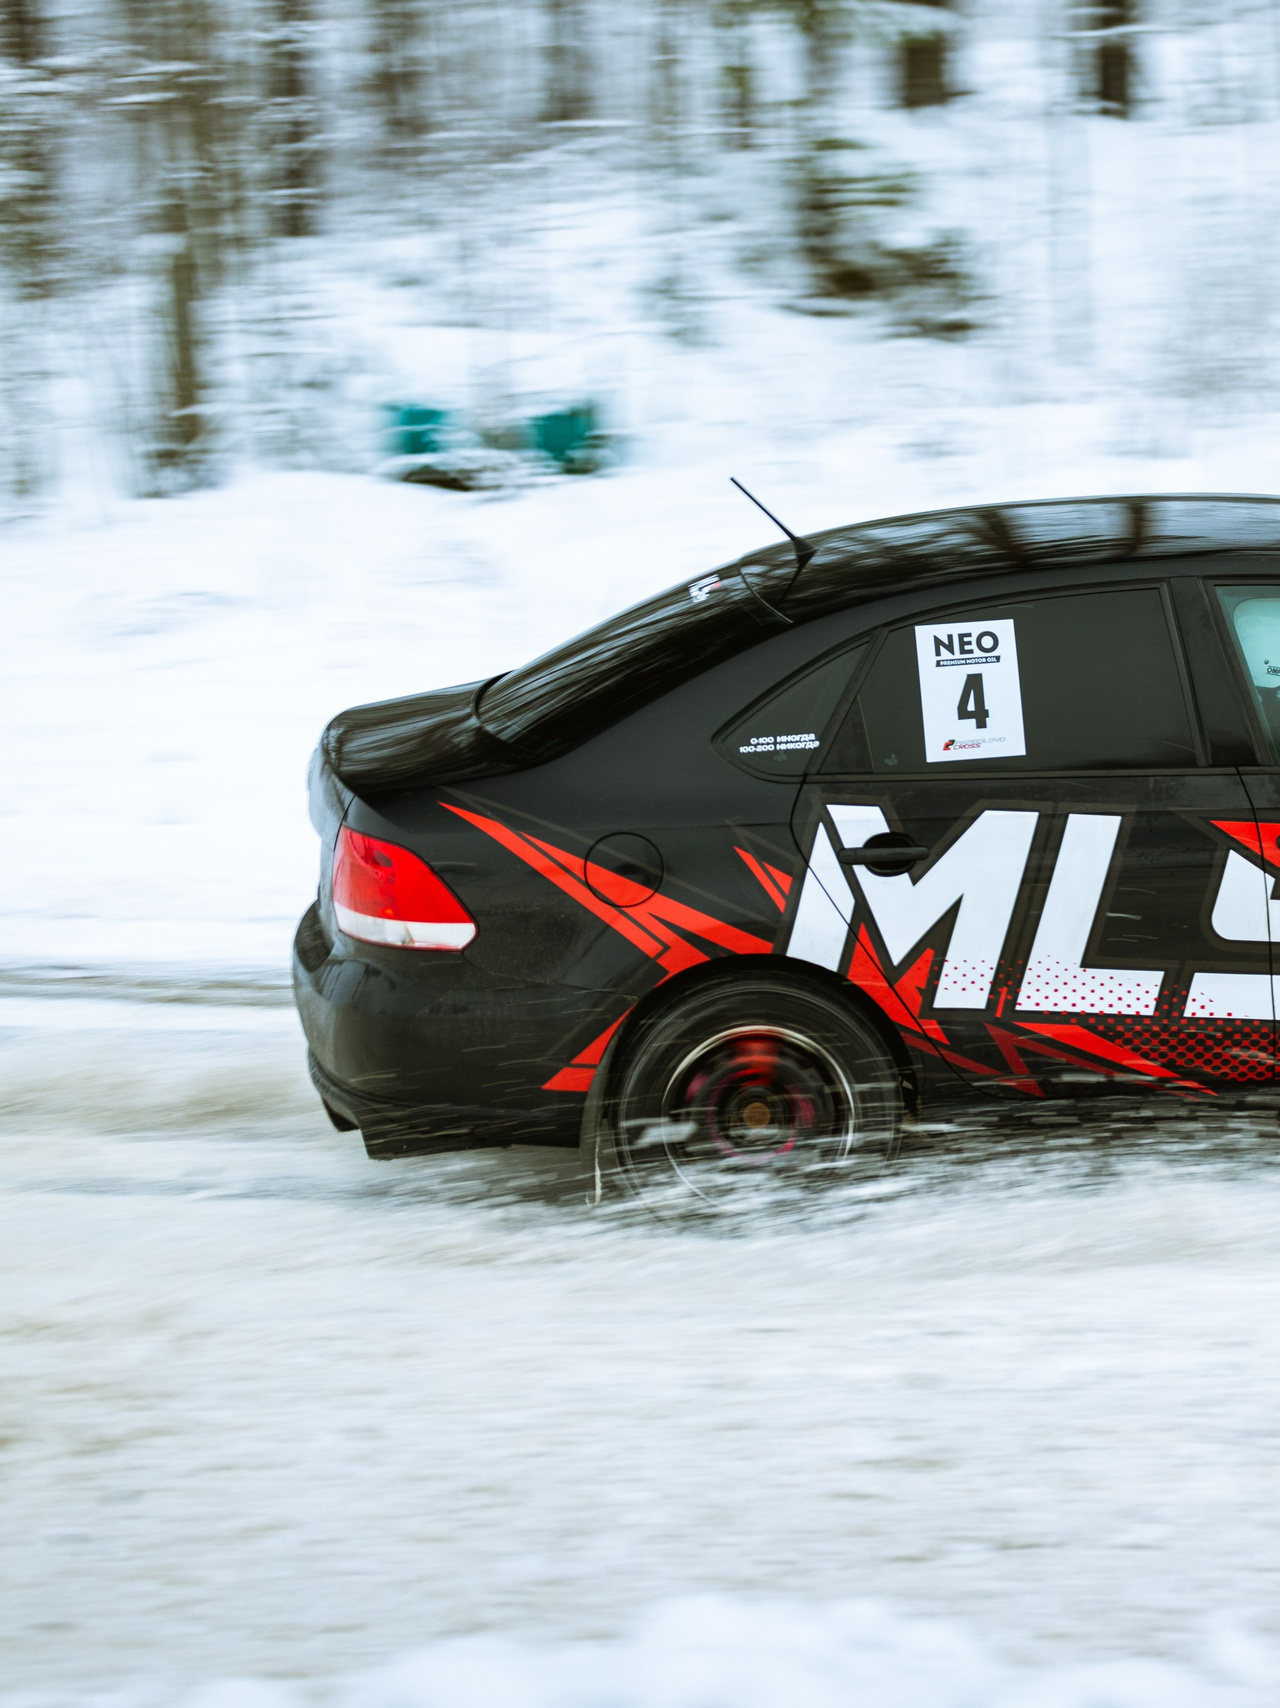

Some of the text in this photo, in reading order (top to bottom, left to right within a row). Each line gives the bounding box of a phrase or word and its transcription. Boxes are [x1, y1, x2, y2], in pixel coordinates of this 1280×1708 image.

[933, 630, 999, 657] NEO
[957, 673, 990, 730] 4
[953, 742, 981, 750] CROSS
